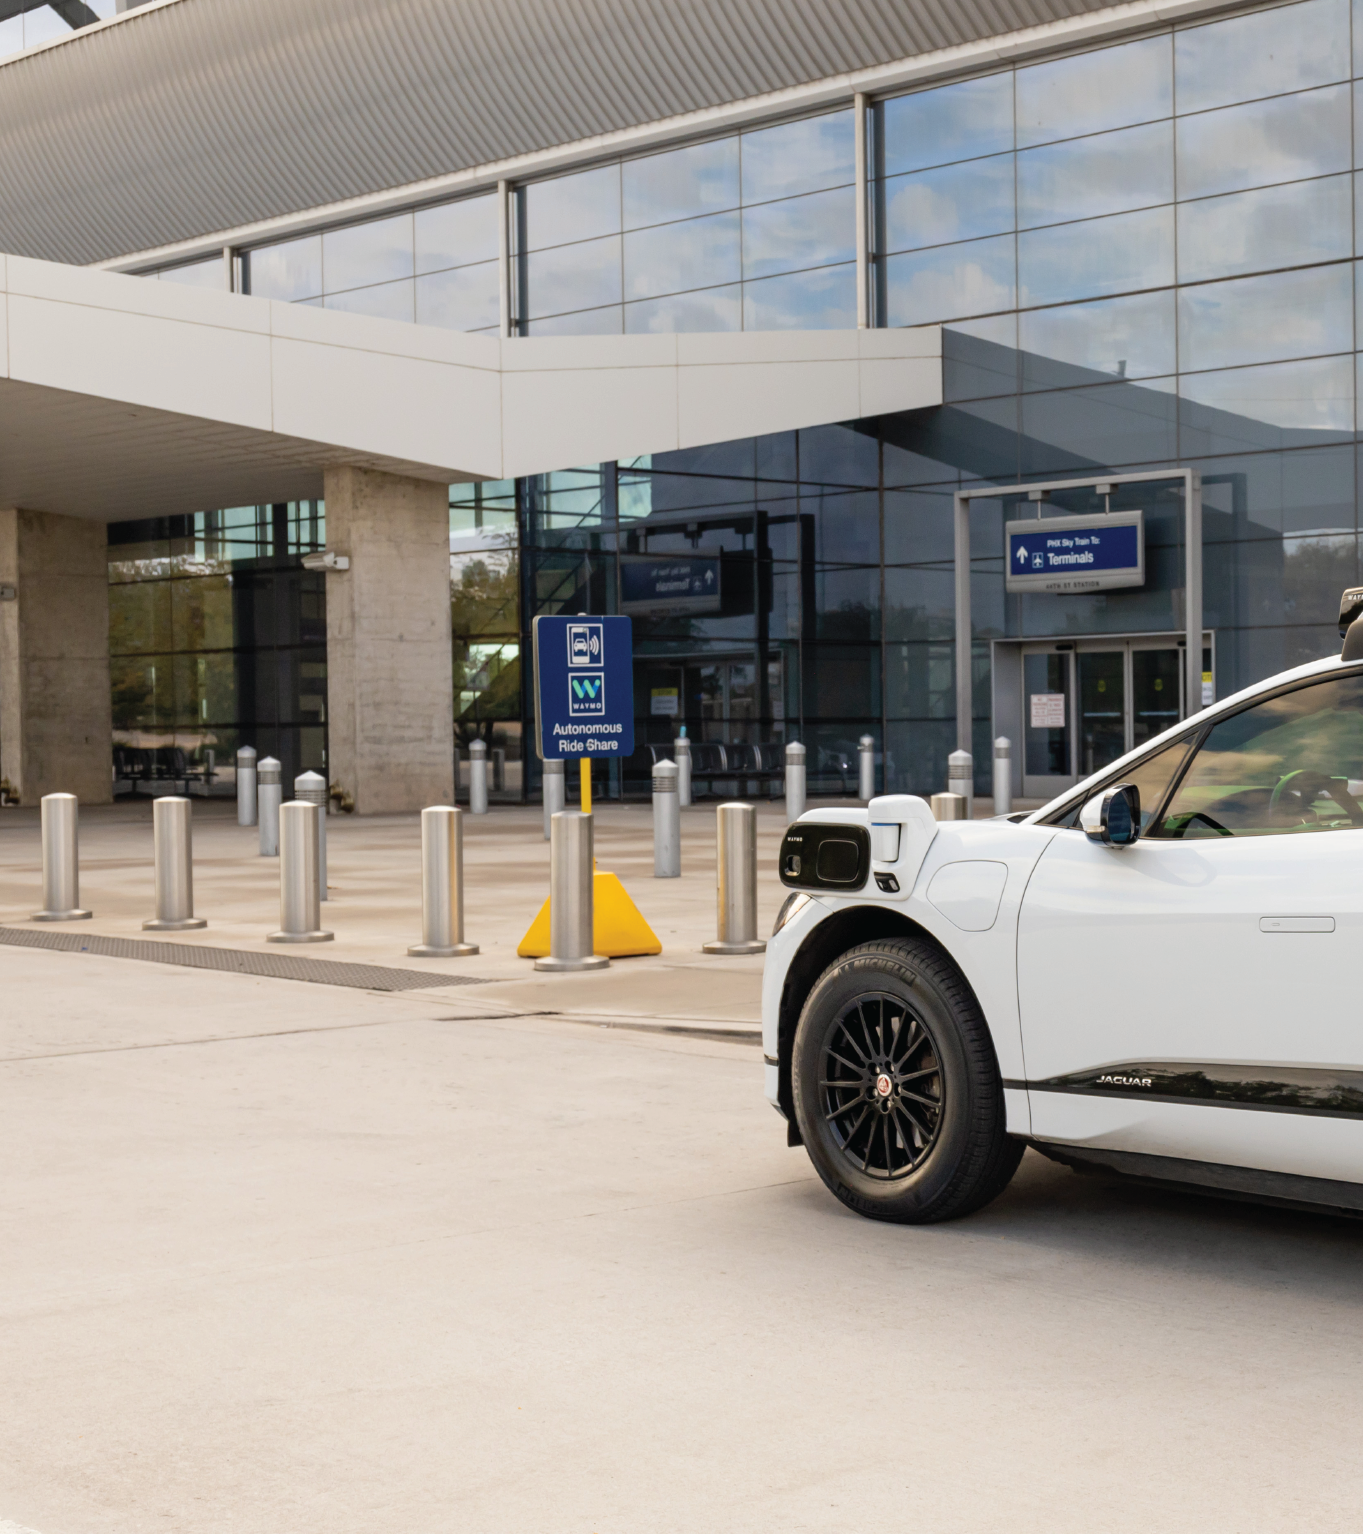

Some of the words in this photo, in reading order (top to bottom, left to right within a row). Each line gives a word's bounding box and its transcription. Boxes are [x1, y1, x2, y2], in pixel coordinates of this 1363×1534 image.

[1047, 539, 1061, 548] PHX
[1062, 538, 1074, 548] Sky
[1074, 537, 1090, 546] Train
[1047, 551, 1094, 565] Terminals
[573, 702, 602, 710] WAYMO
[552, 722, 623, 736] Autonomous
[559, 739, 584, 753] Ride
[586, 738, 618, 752] Share
[1096, 1075, 1152, 1087] JAGUAR
